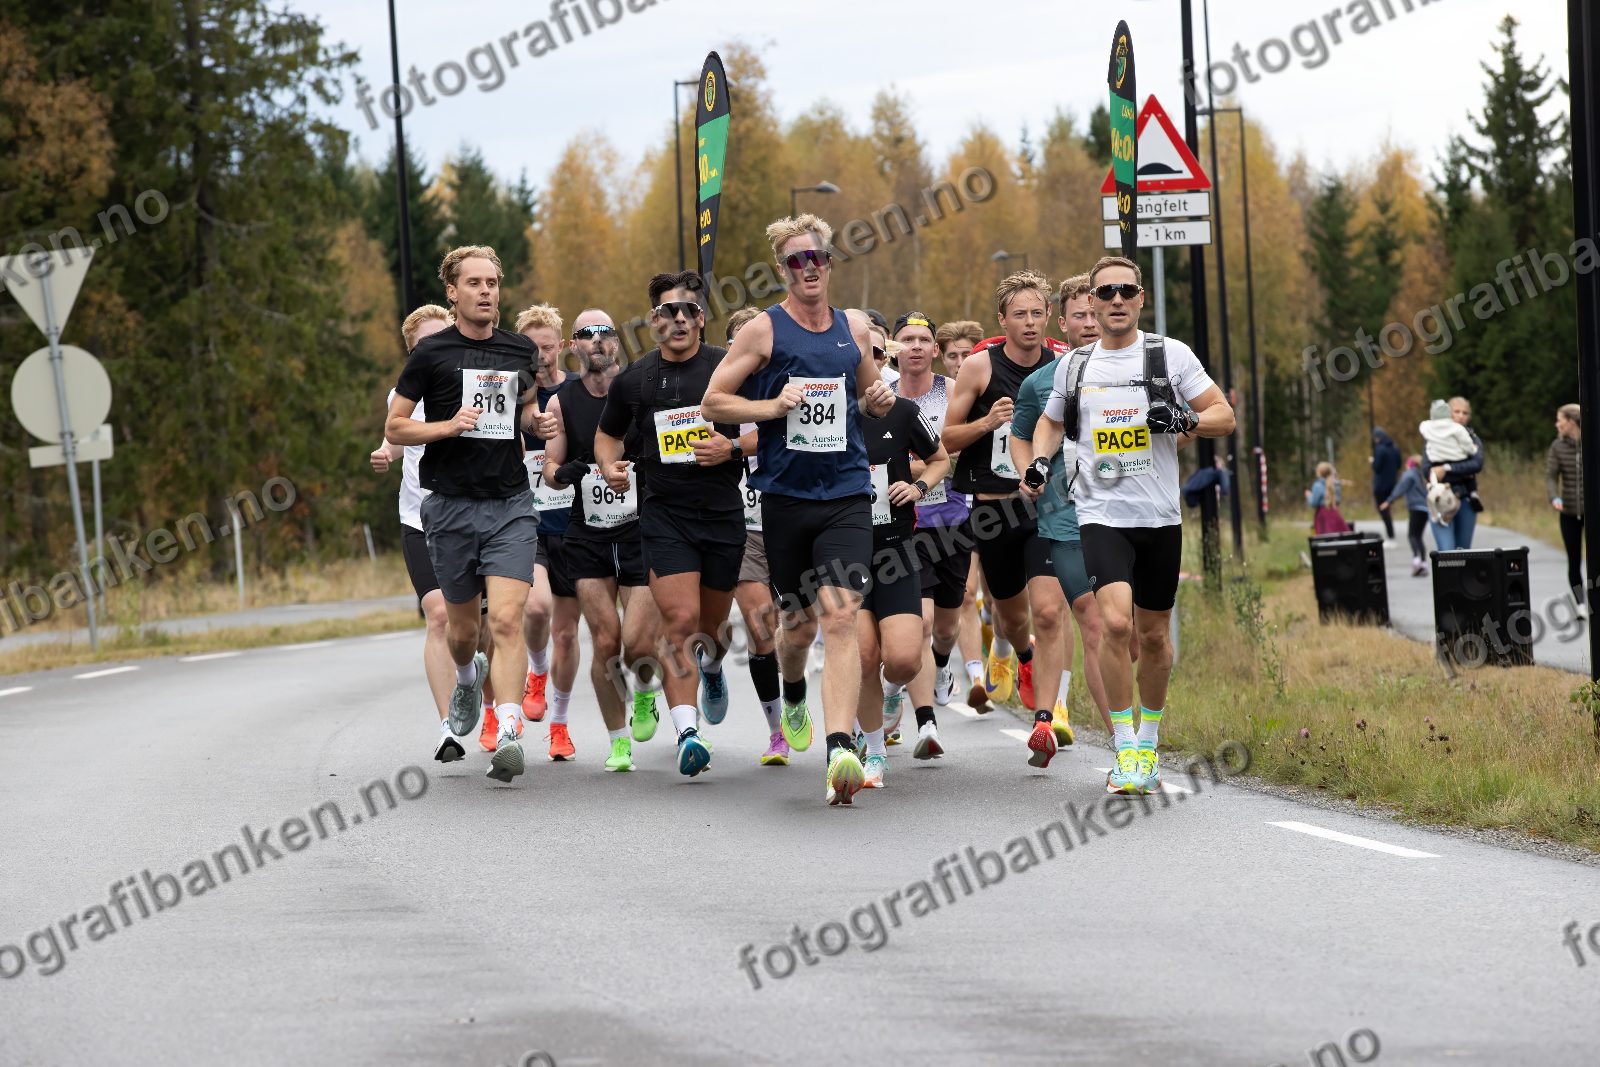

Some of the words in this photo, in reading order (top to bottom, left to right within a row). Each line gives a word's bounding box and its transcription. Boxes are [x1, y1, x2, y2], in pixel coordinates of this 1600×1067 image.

[1137, 199, 1188, 215] angfelt
[1165, 228, 1186, 240] km
[476, 374, 509, 382] NORGES
[803, 383, 839, 391] NORGES
[805, 390, 833, 398] LØPET
[473, 392, 506, 413] 818
[667, 410, 701, 421] NORGES
[799, 402, 836, 426] 384
[1102, 407, 1139, 417] NORGES
[1105, 415, 1134, 424] LØPET
[811, 434, 844, 444] Aurskog
[999, 434, 1007, 454] 1
[1097, 428, 1147, 450] PACE
[1118, 459, 1151, 468] Aurskog
[532, 471, 543, 488] 7
[591, 485, 626, 505] 964
[746, 489, 762, 508] 9
[926, 490, 944, 498] skog
